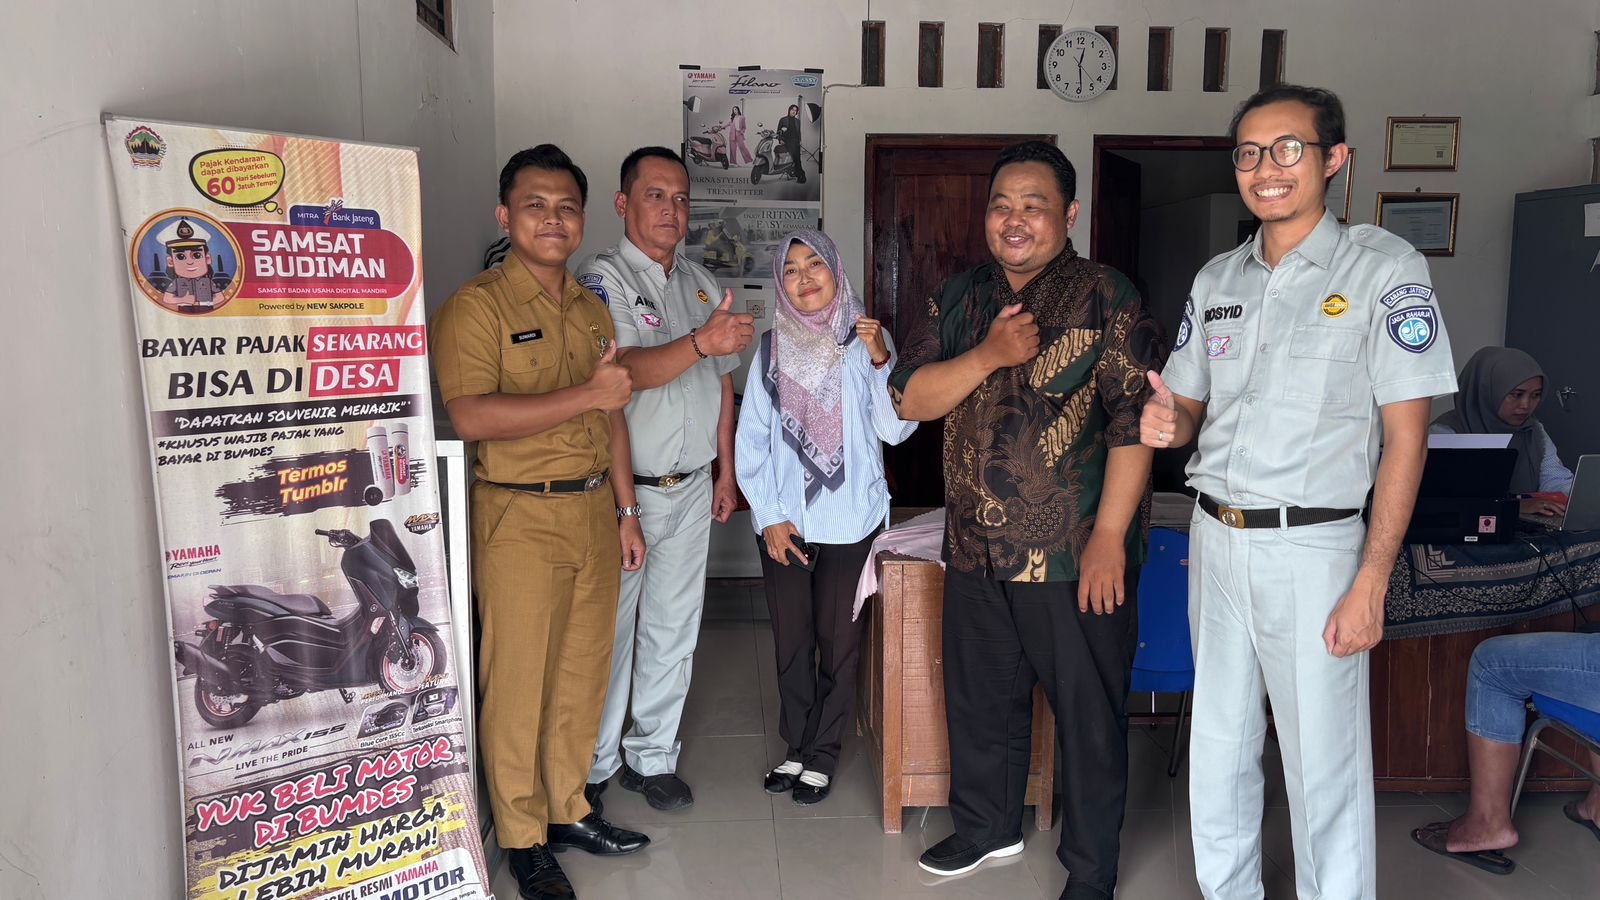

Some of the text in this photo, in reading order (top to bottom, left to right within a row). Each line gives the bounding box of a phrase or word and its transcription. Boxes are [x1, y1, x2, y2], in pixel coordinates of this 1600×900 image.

[1065, 40, 1072, 48] 11
[1099, 50, 1104, 58] 2
[1052, 61, 1058, 69] 9
[1102, 62, 1107, 70] 3
[1089, 83, 1094, 91] 5
[200, 155, 266, 169] Pajak Kendaraan
[201, 162, 269, 176] dapat dibayarkan
[250, 172, 277, 180] Sebelum
[207, 176, 236, 196] 60
[238, 180, 278, 190] Jatuh Tempo
[297, 212, 374, 225] MITRA Bank Jateng
[251, 229, 365, 255] SAMSAT
[254, 255, 386, 279] BUDIMAN
[1386, 289, 1408, 304] CABANG
[1205, 305, 1243, 324] ROSYID
[1392, 311, 1430, 324] JASA RAHARJA
[142, 332, 423, 358] BAYAR PAJAK SEKARANG
[168, 362, 394, 400] BISA DI DESA
[267, 406, 336, 422] SOUVENIR
[224, 432, 267, 445] WAJIB
[271, 429, 311, 440] PAJAK
[314, 426, 344, 437] YANG
[158, 446, 275, 466] BAYAR DI BUMDES
[278, 460, 348, 485] Termos
[280, 477, 348, 504] Tumblr
[171, 544, 221, 560] YAMAHA
[418, 678, 450, 690] FEATURE
[304, 723, 347, 740] 155
[187, 734, 234, 750] ALL NEW
[360, 740, 374, 748] Blue
[376, 736, 388, 744] Core
[236, 746, 308, 770] LIVE THE PRIDE
[197, 736, 453, 831] YUK BELI MOTOR
[255, 776, 418, 848] DI BUMDES
[220, 802, 446, 890] DIJAMIN HARGA
[337, 826, 437, 877] MURAH!
[360, 876, 392, 898] RESMI
[395, 860, 438, 884] YAMAHA
